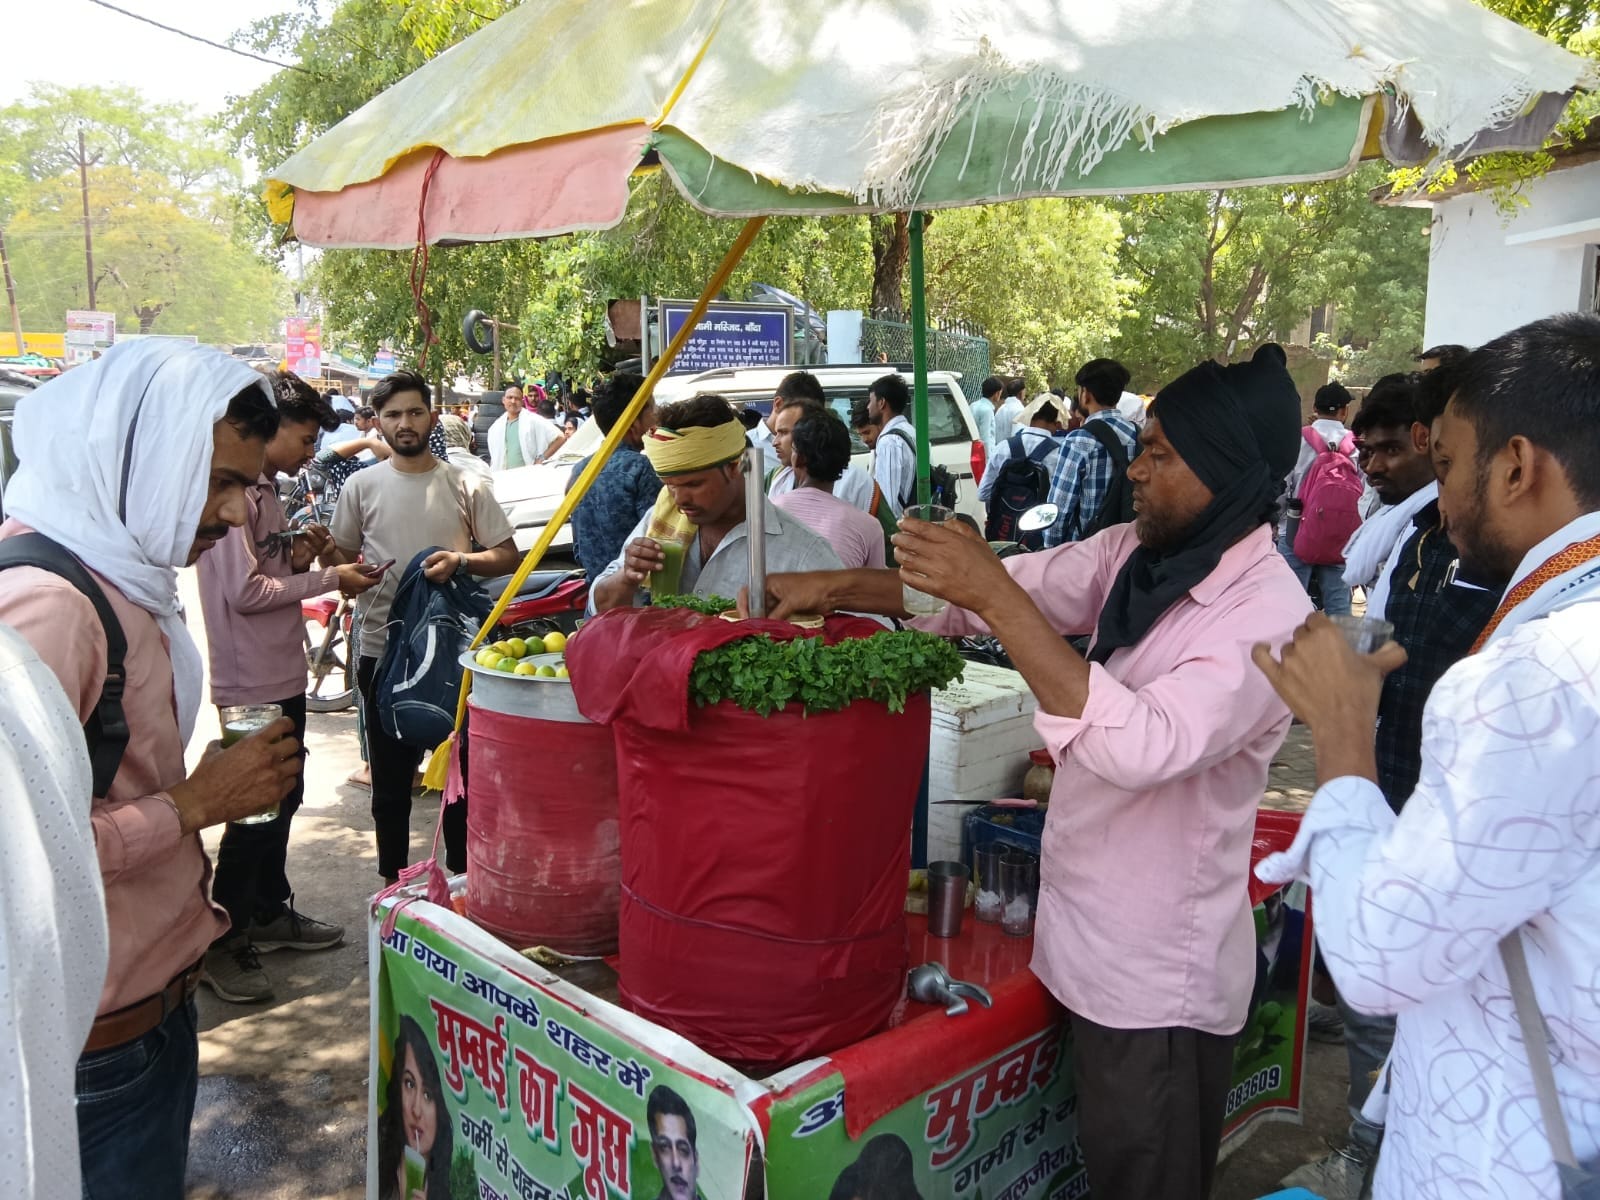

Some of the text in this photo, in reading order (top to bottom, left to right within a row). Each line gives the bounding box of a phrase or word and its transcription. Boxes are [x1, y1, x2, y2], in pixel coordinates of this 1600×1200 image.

[413, 939, 457, 983] गया
[462, 969, 540, 1027] आपके
[547, 1020, 612, 1075] शहर
[616, 1055, 651, 1096] में
[430, 999, 632, 1200] मुम्बई का जूस
[1227, 1066, 1280, 1115] 883609
[460, 1112, 493, 1160] गर्मी
[496, 1137, 509, 1177] से
[954, 1094, 1077, 1193] गर्मी से रा
